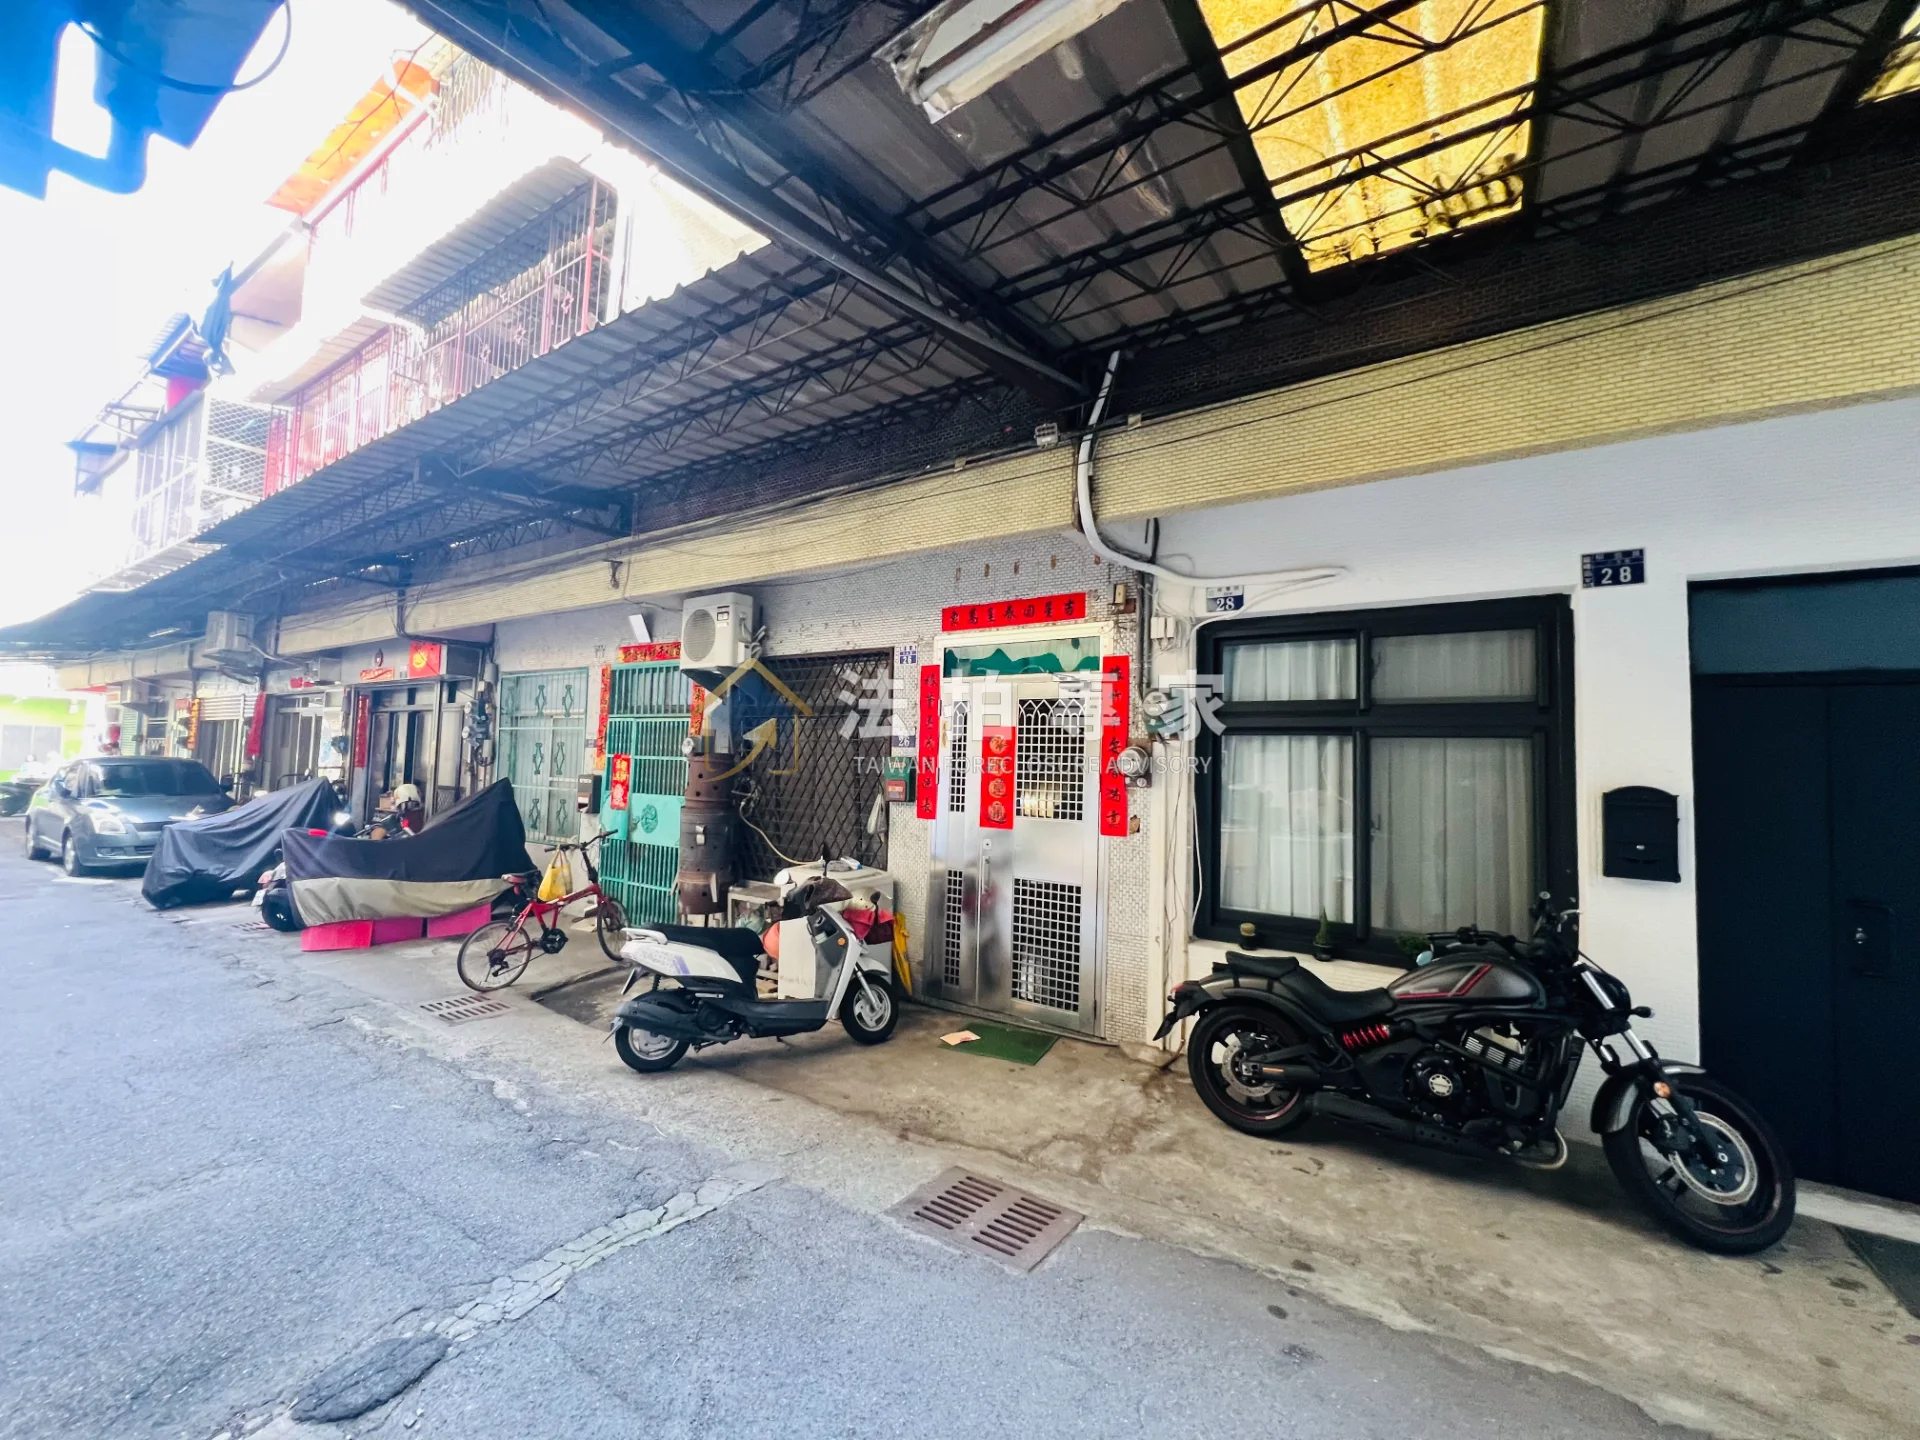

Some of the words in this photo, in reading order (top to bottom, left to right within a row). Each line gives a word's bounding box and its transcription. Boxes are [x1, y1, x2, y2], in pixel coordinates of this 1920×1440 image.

[1601, 566, 1631, 584] 28
[1216, 597, 1234, 611] 28
[902, 655, 913, 664] 26
[898, 735, 910, 747] 26
